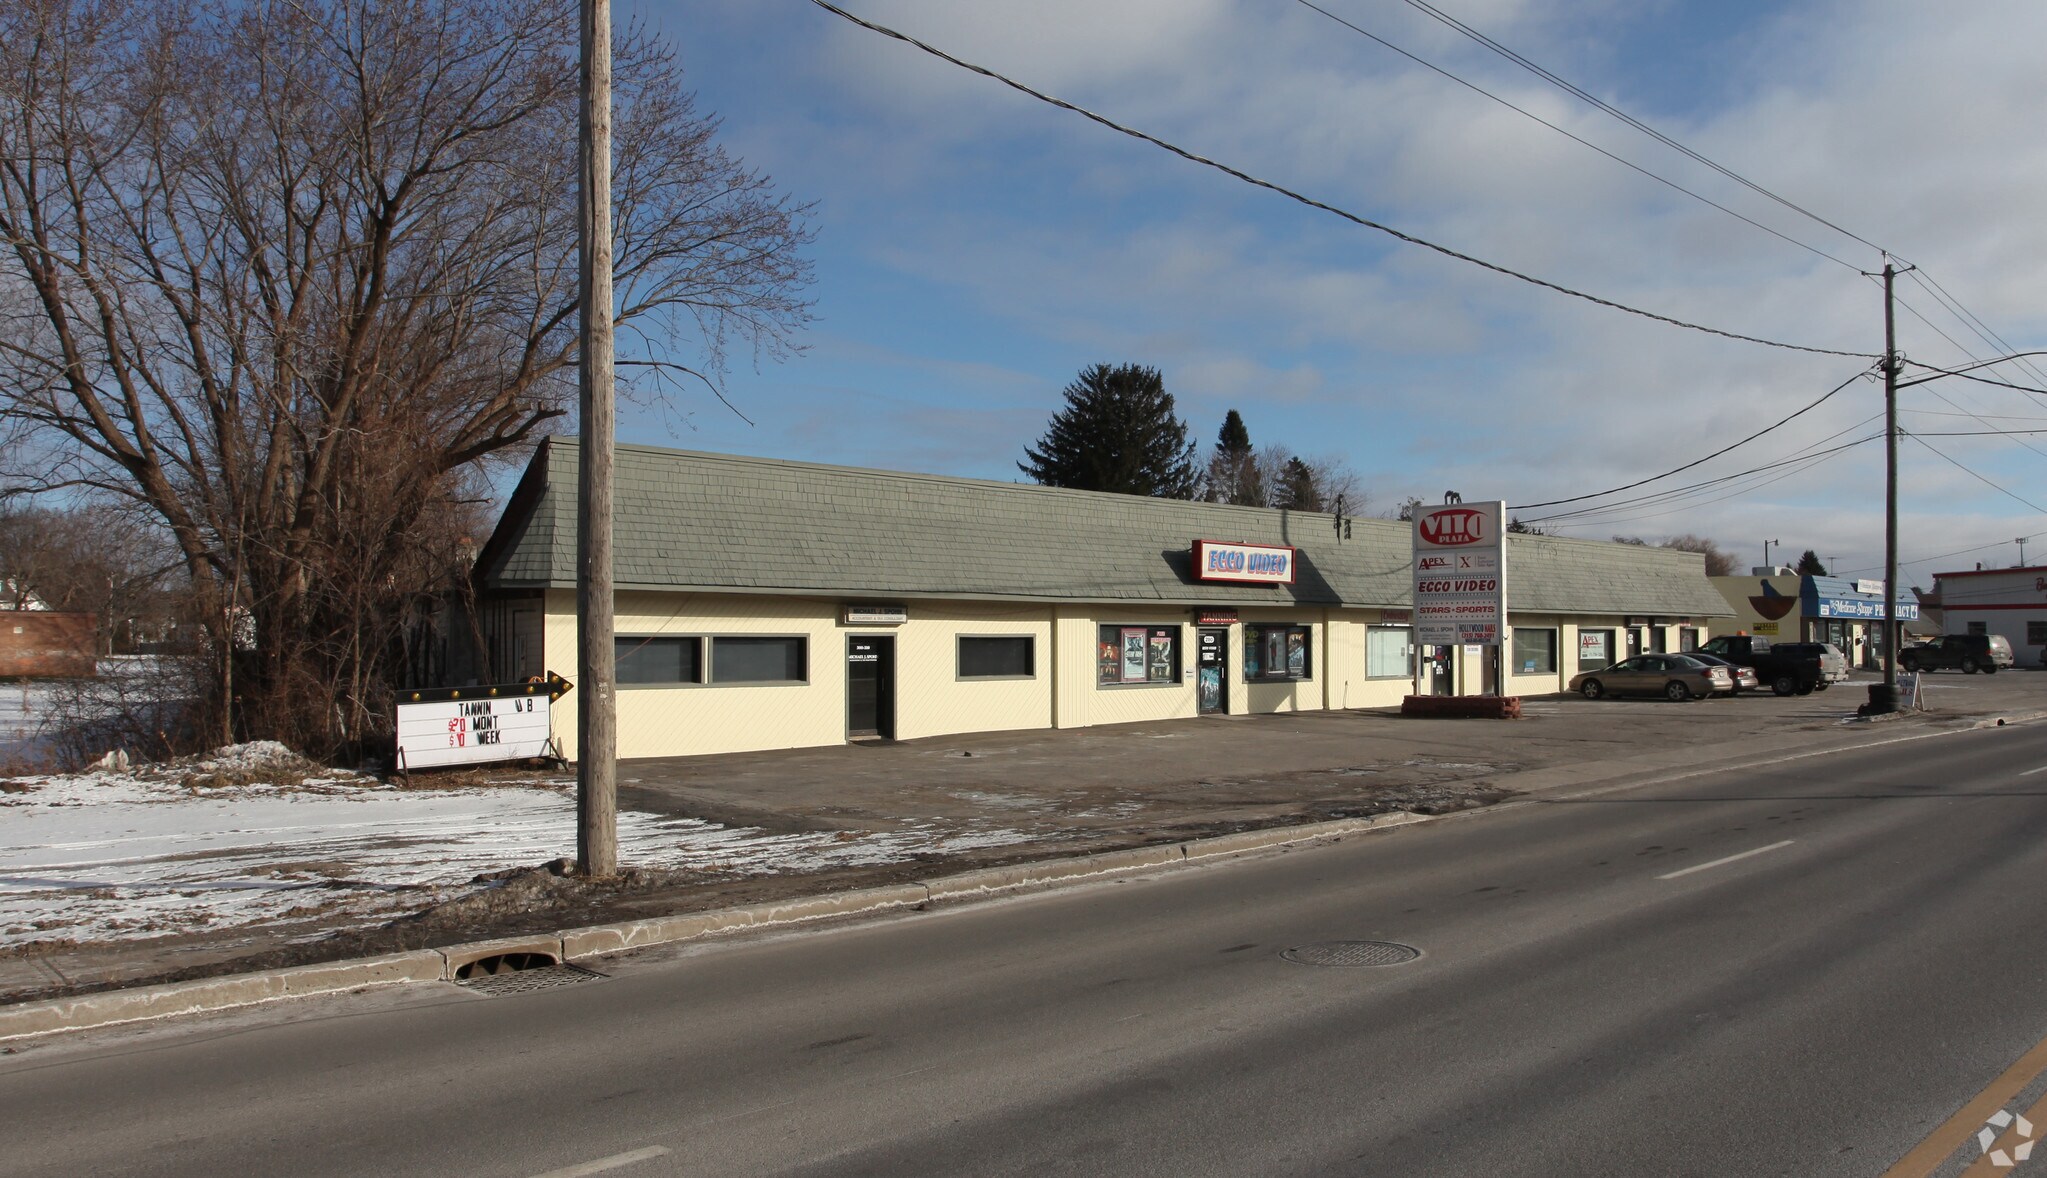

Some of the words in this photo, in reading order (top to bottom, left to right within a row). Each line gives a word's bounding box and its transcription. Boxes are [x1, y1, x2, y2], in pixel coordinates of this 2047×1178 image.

[1438, 534, 1470, 543] PLAZA
[1208, 550, 1245, 573] ECCO
[1247, 552, 1287, 575] VIDEO
[1418, 557, 1446, 570] APEX
[1418, 581, 1451, 593] ECCO
[1454, 579, 1497, 592] VIDEO
[1455, 605, 1495, 614] SPORTS
[1201, 612, 1238, 621] TANNING
[1459, 624, 1484, 633] HOLLYWOOD
[1484, 624, 1496, 632] NAILS
[459, 701, 491, 717] TANNIN
[515, 699, 523, 713] U
[527, 698, 533, 712] B
[473, 715, 498, 731] MONT
[477, 730, 501, 745] WEEK
